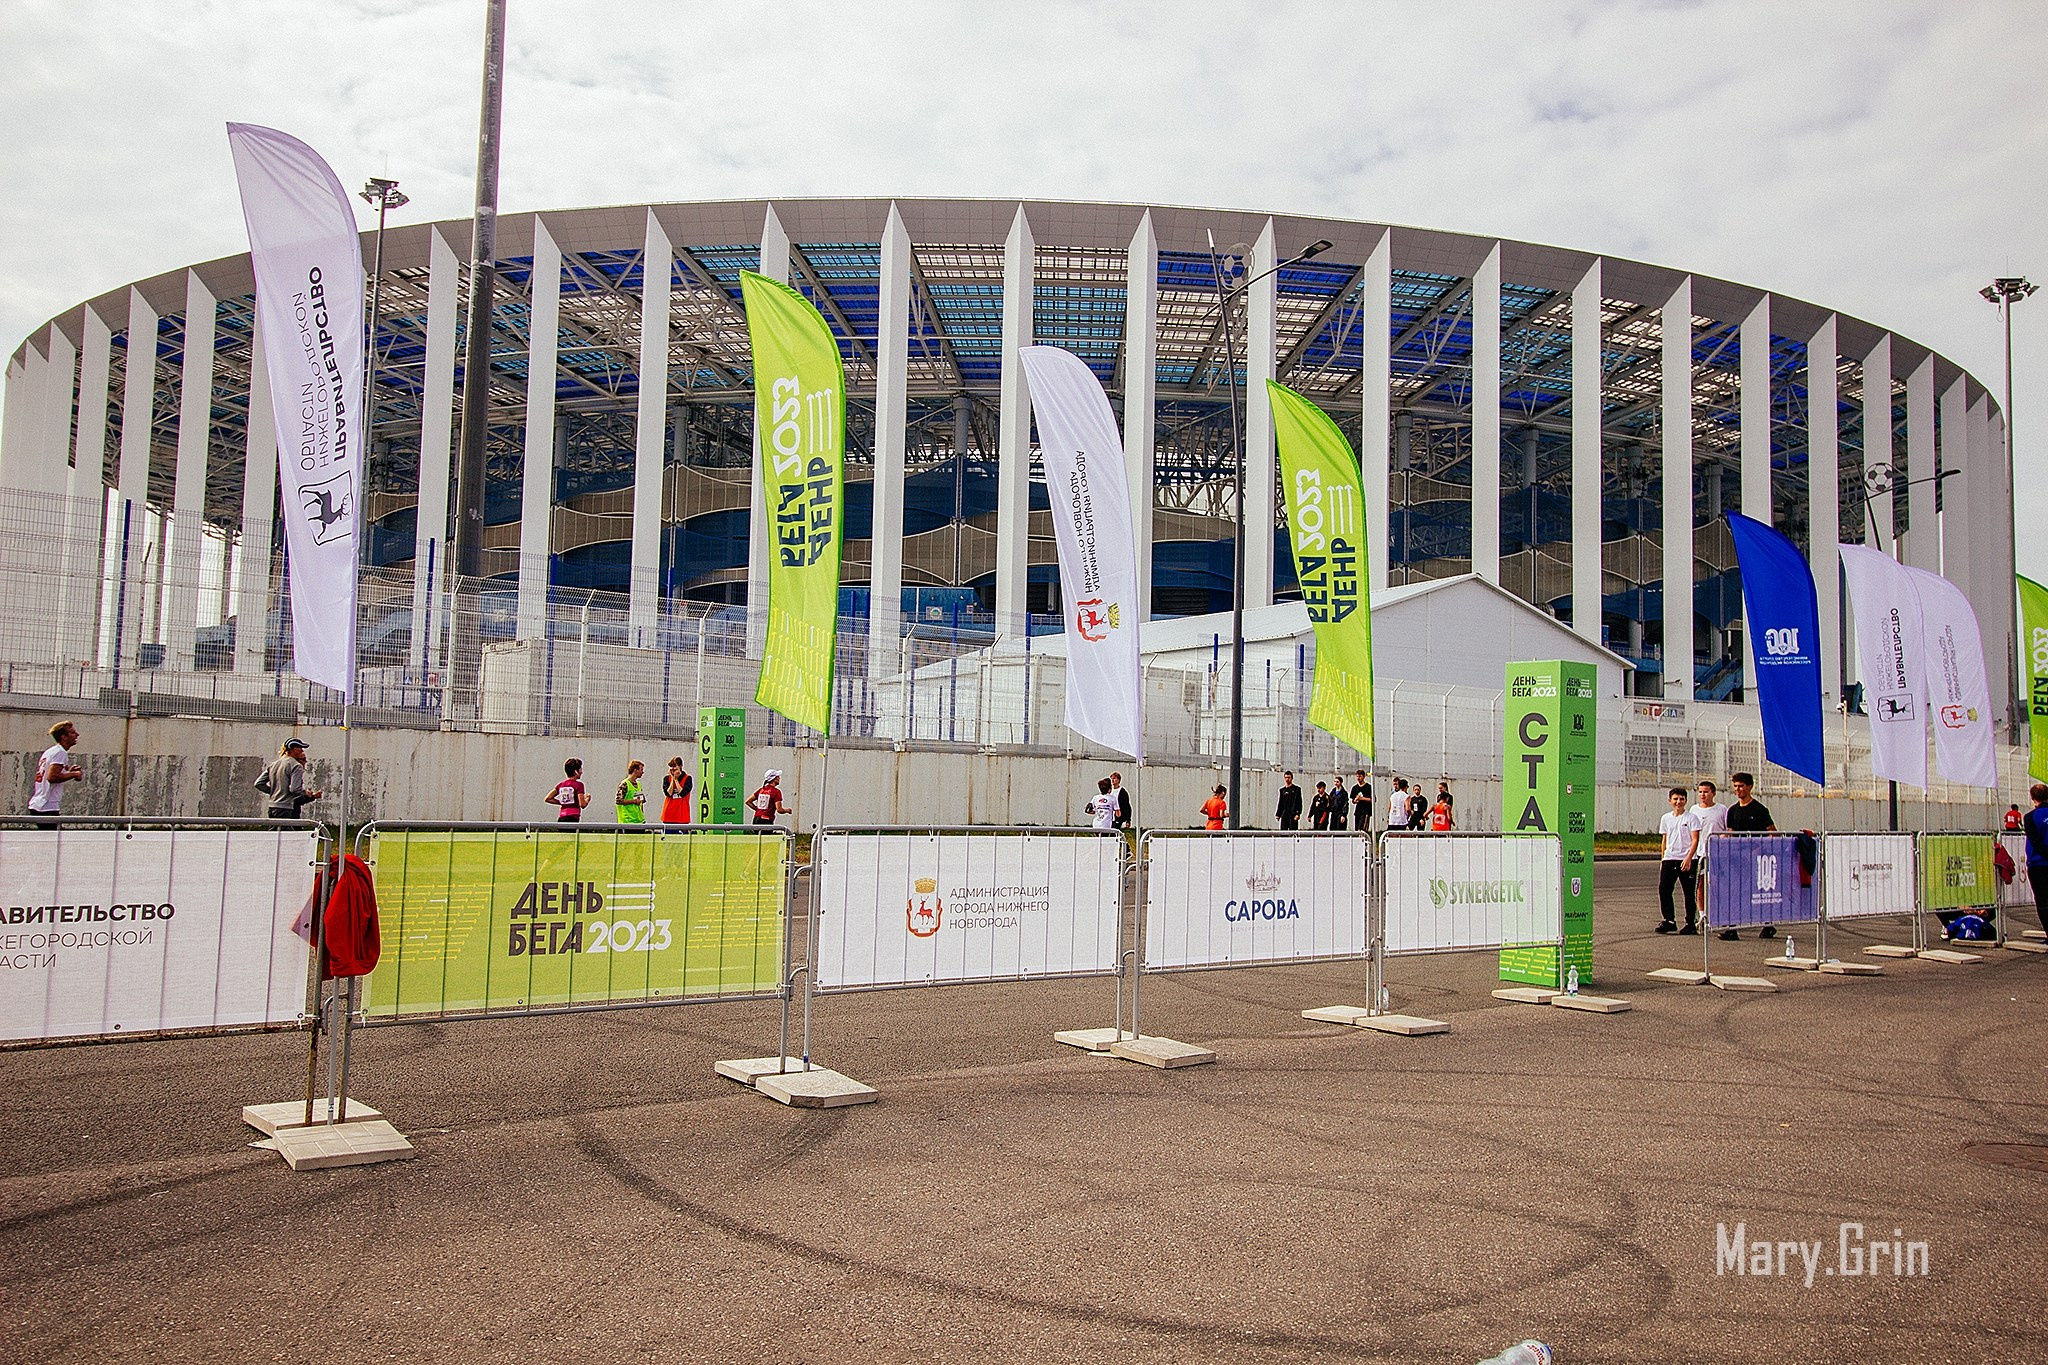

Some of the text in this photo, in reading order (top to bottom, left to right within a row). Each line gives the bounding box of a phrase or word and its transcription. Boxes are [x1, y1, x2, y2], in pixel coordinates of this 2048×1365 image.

[1512, 676, 1537, 687] ДЕНЬ
[1566, 677, 1581, 687] ДЕНЬ
[1512, 687, 1557, 697] БЕГА 2023
[1566, 687, 1593, 698] БЕГА 2023
[1517, 712, 1549, 832] СТА
[701, 735, 711, 824] СТАР
[950, 886, 1049, 900] АДМИНИСТРАЦИЯ
[1449, 880, 1524, 905] SYNERGETIC
[511, 882, 603, 919] ДЕНЬ
[950, 901, 1050, 915] ГОРОДА НИЖНЕГО
[1225, 898, 1300, 923] САРОВА
[950, 917, 1018, 929] НОВГОРОДА
[508, 919, 673, 956] БЕГА 2023
